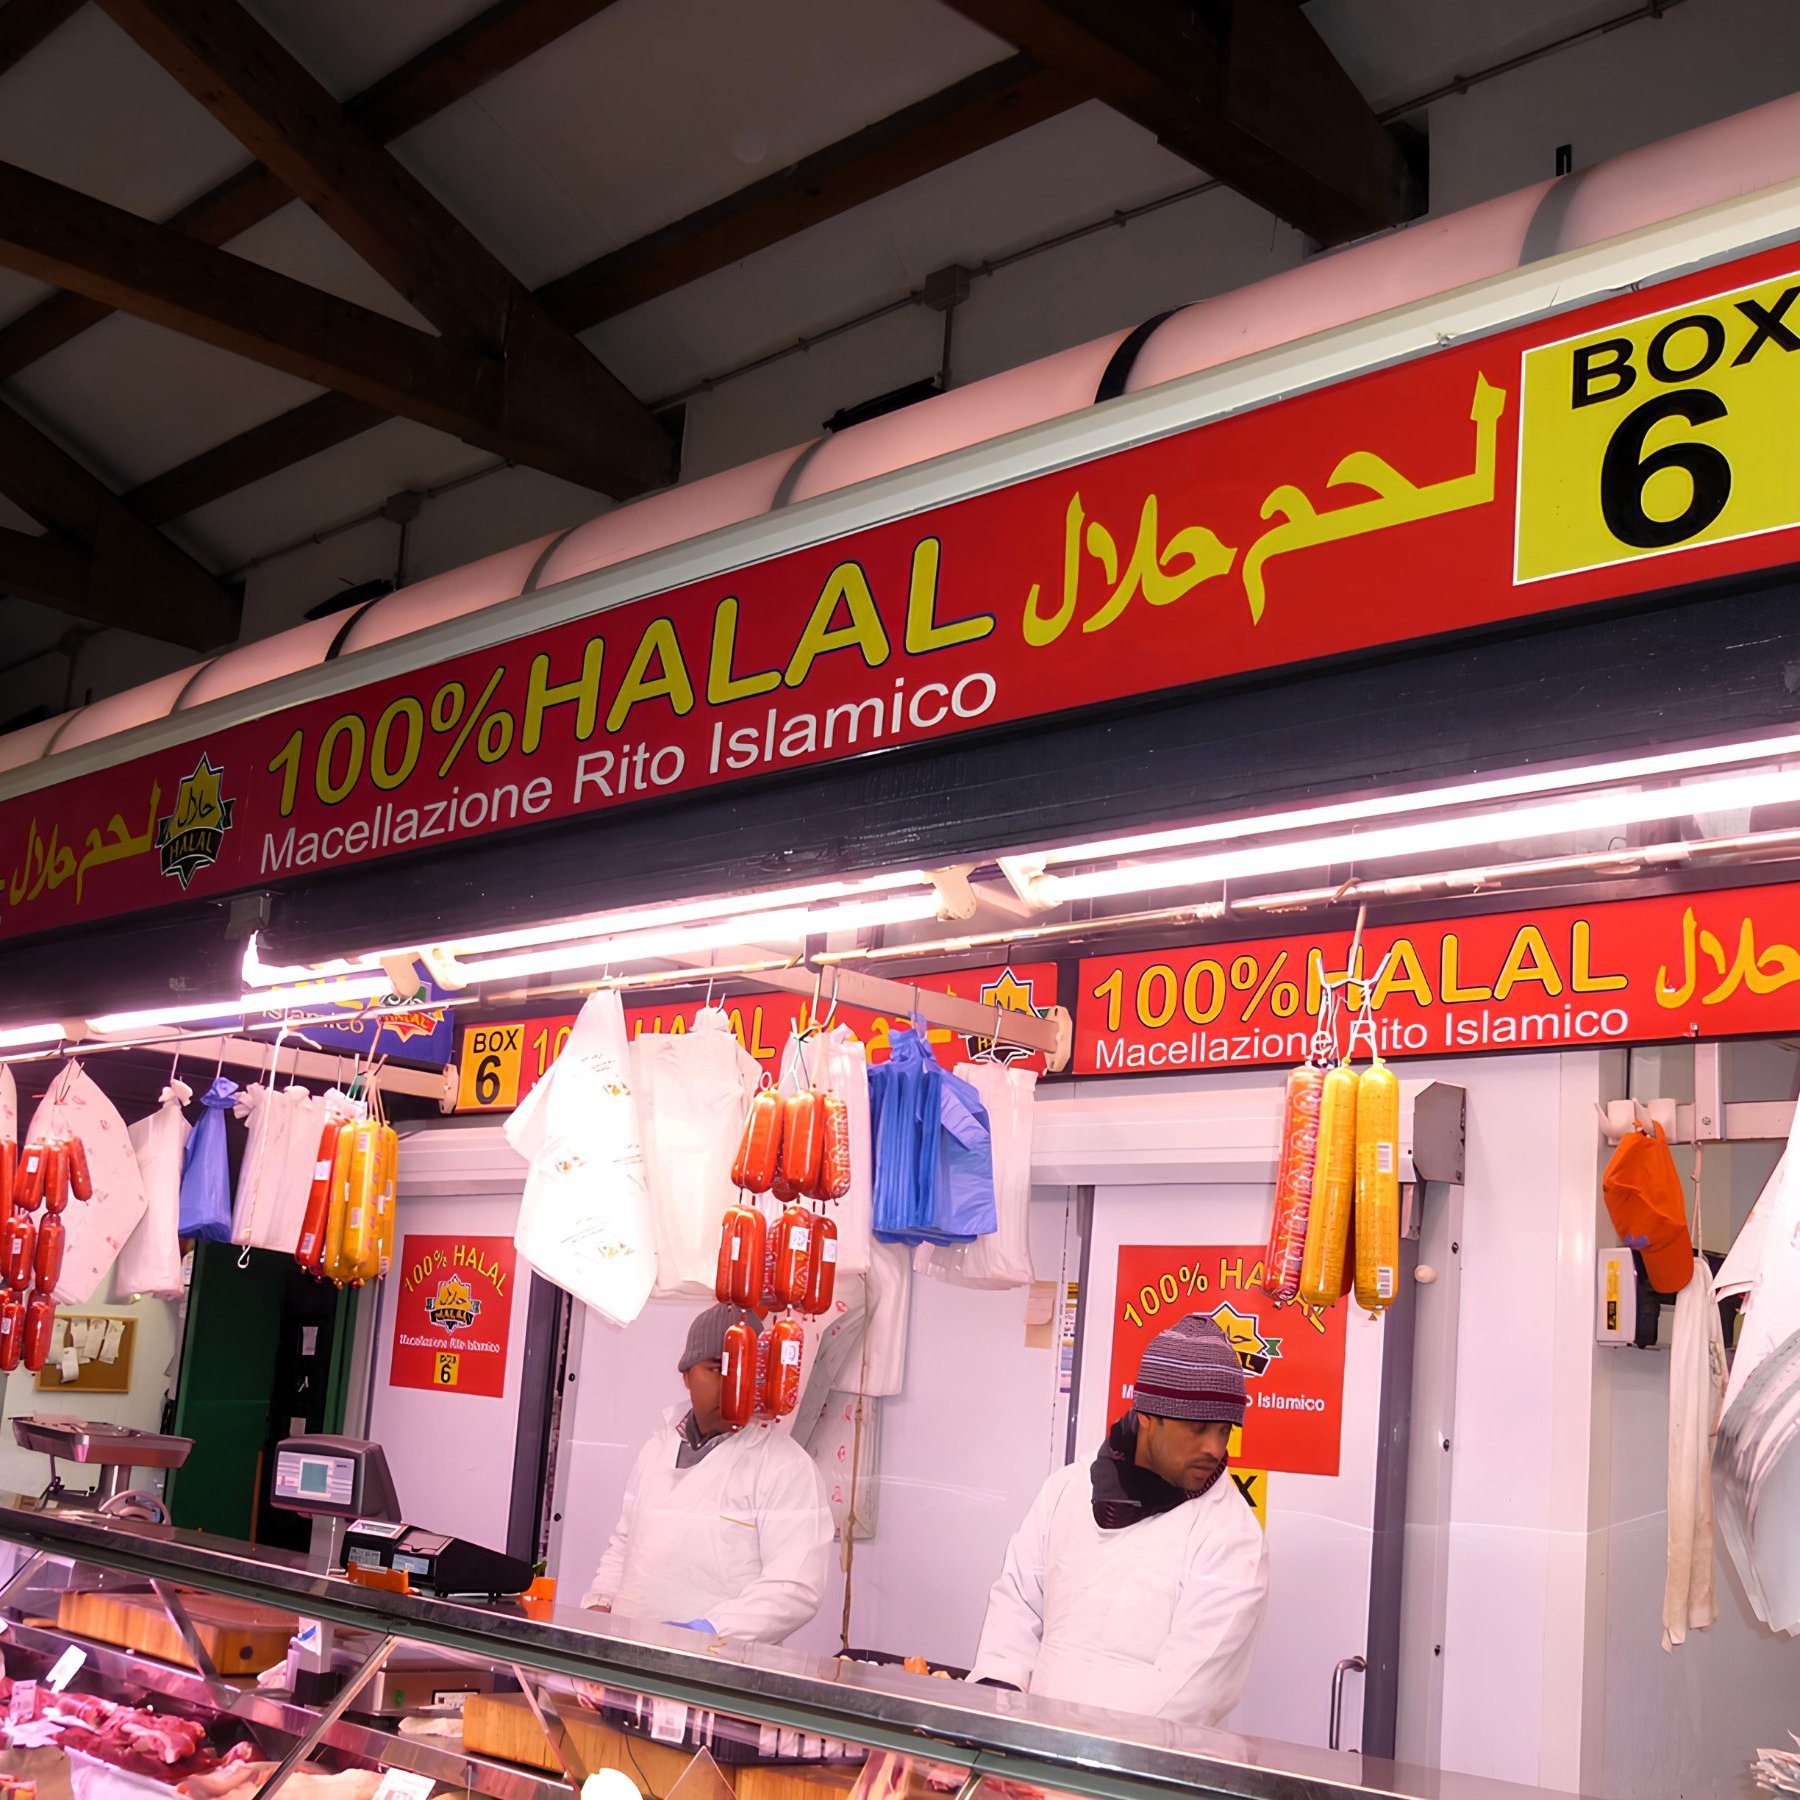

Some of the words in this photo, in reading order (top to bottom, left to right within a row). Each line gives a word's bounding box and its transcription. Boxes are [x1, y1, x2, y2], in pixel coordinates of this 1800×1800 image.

[1572, 285, 1800, 410] BOX
[1600, 388, 1732, 549] 6
[1022, 490, 1239, 647] حلال
[260, 775, 552, 875] Macellazione
[572, 742, 685, 805] Rito
[708, 672, 997, 774] Islamico
[169, 831, 214, 863] HALAL
[473, 1028, 520, 1053] BOX
[1095, 1027, 1334, 1070] Macellazione
[1350, 1017, 1428, 1053] Rito
[1443, 1004, 1629, 1048] Islamico
[476, 1055, 502, 1105] 6
[404, 1249, 447, 1293] 100%
[453, 1244, 507, 1297] HALAL
[1123, 1262, 1208, 1328] 100%
[440, 1363, 452, 1384] 6
[1257, 1392, 1326, 1412] Islamico
